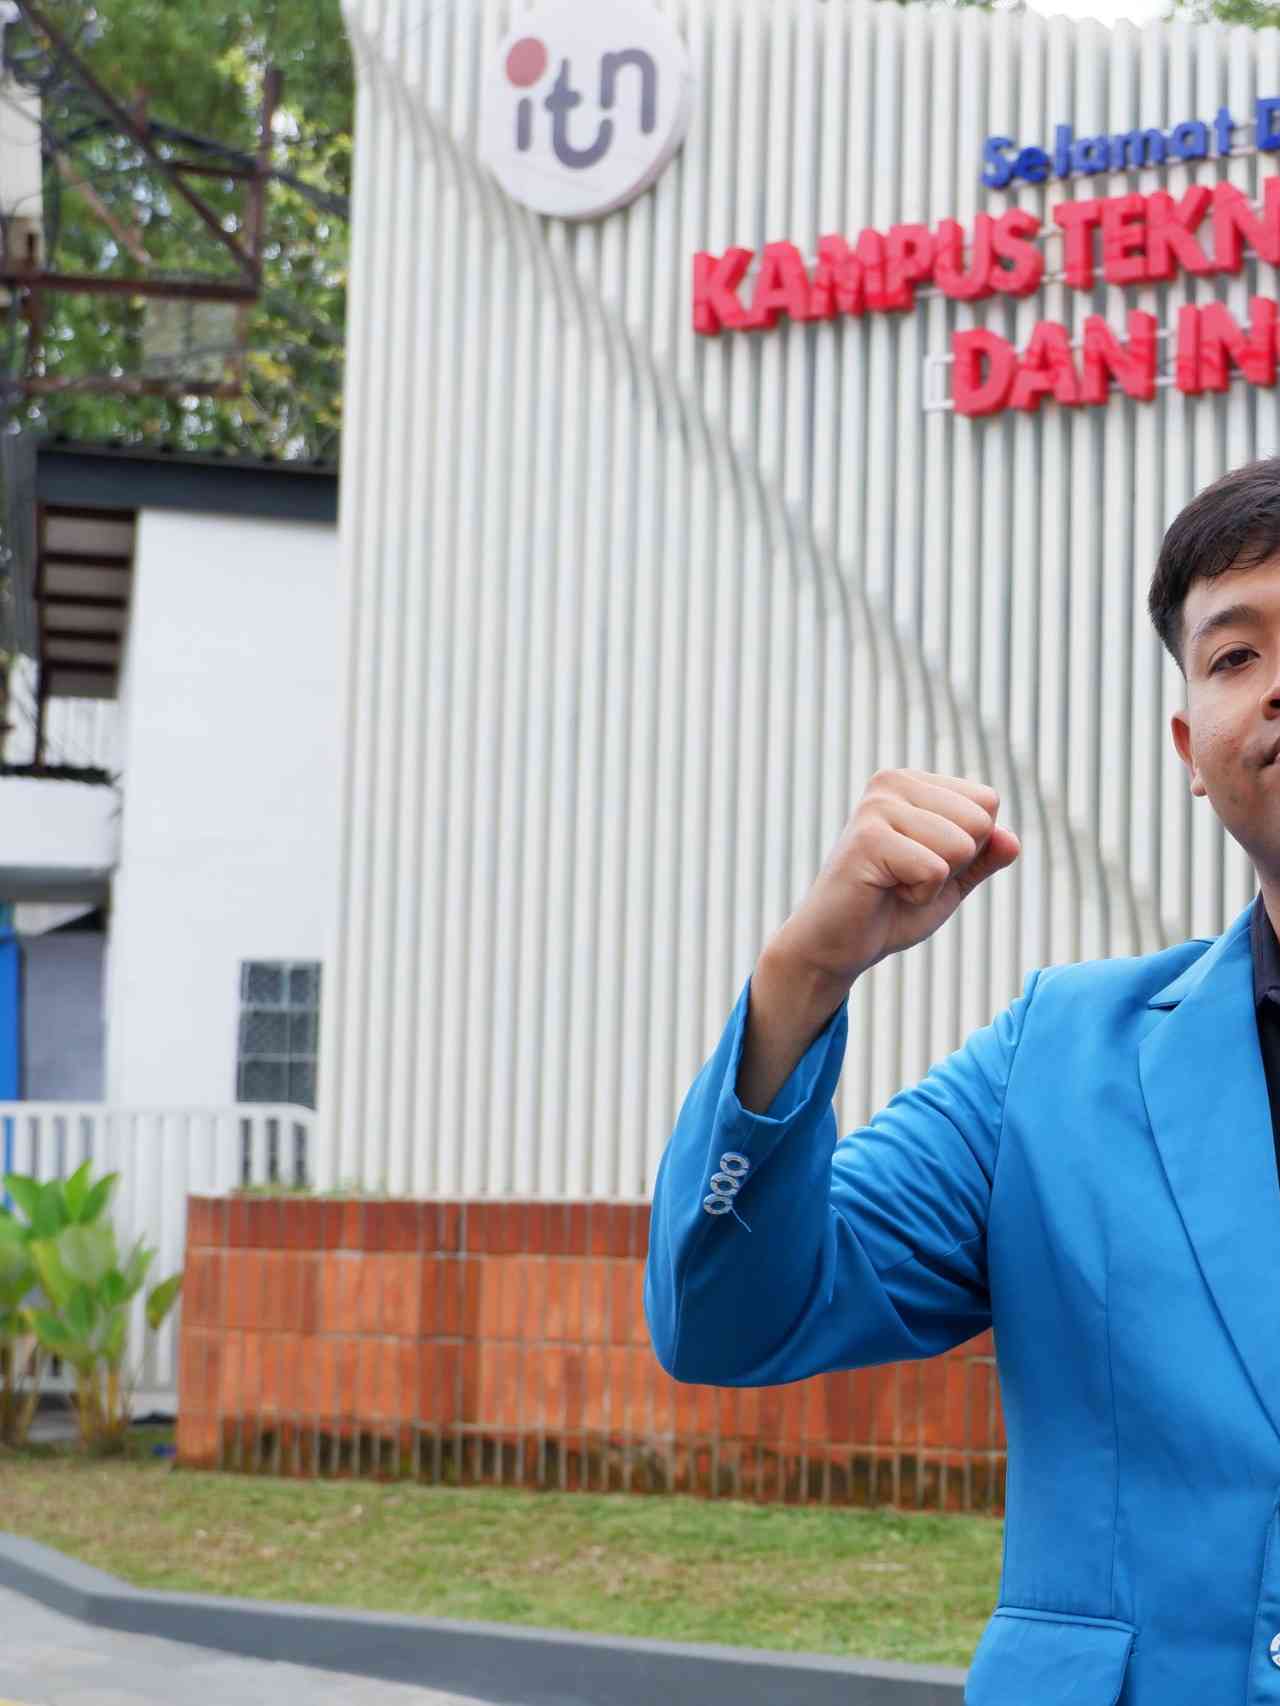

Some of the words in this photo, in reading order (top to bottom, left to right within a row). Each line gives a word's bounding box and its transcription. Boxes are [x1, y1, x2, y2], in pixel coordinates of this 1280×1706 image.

[505, 37, 656, 169] itn
[979, 106, 1236, 190] Selamat
[693, 207, 1045, 337] KAMPUS
[951, 308, 1159, 419] DAN
